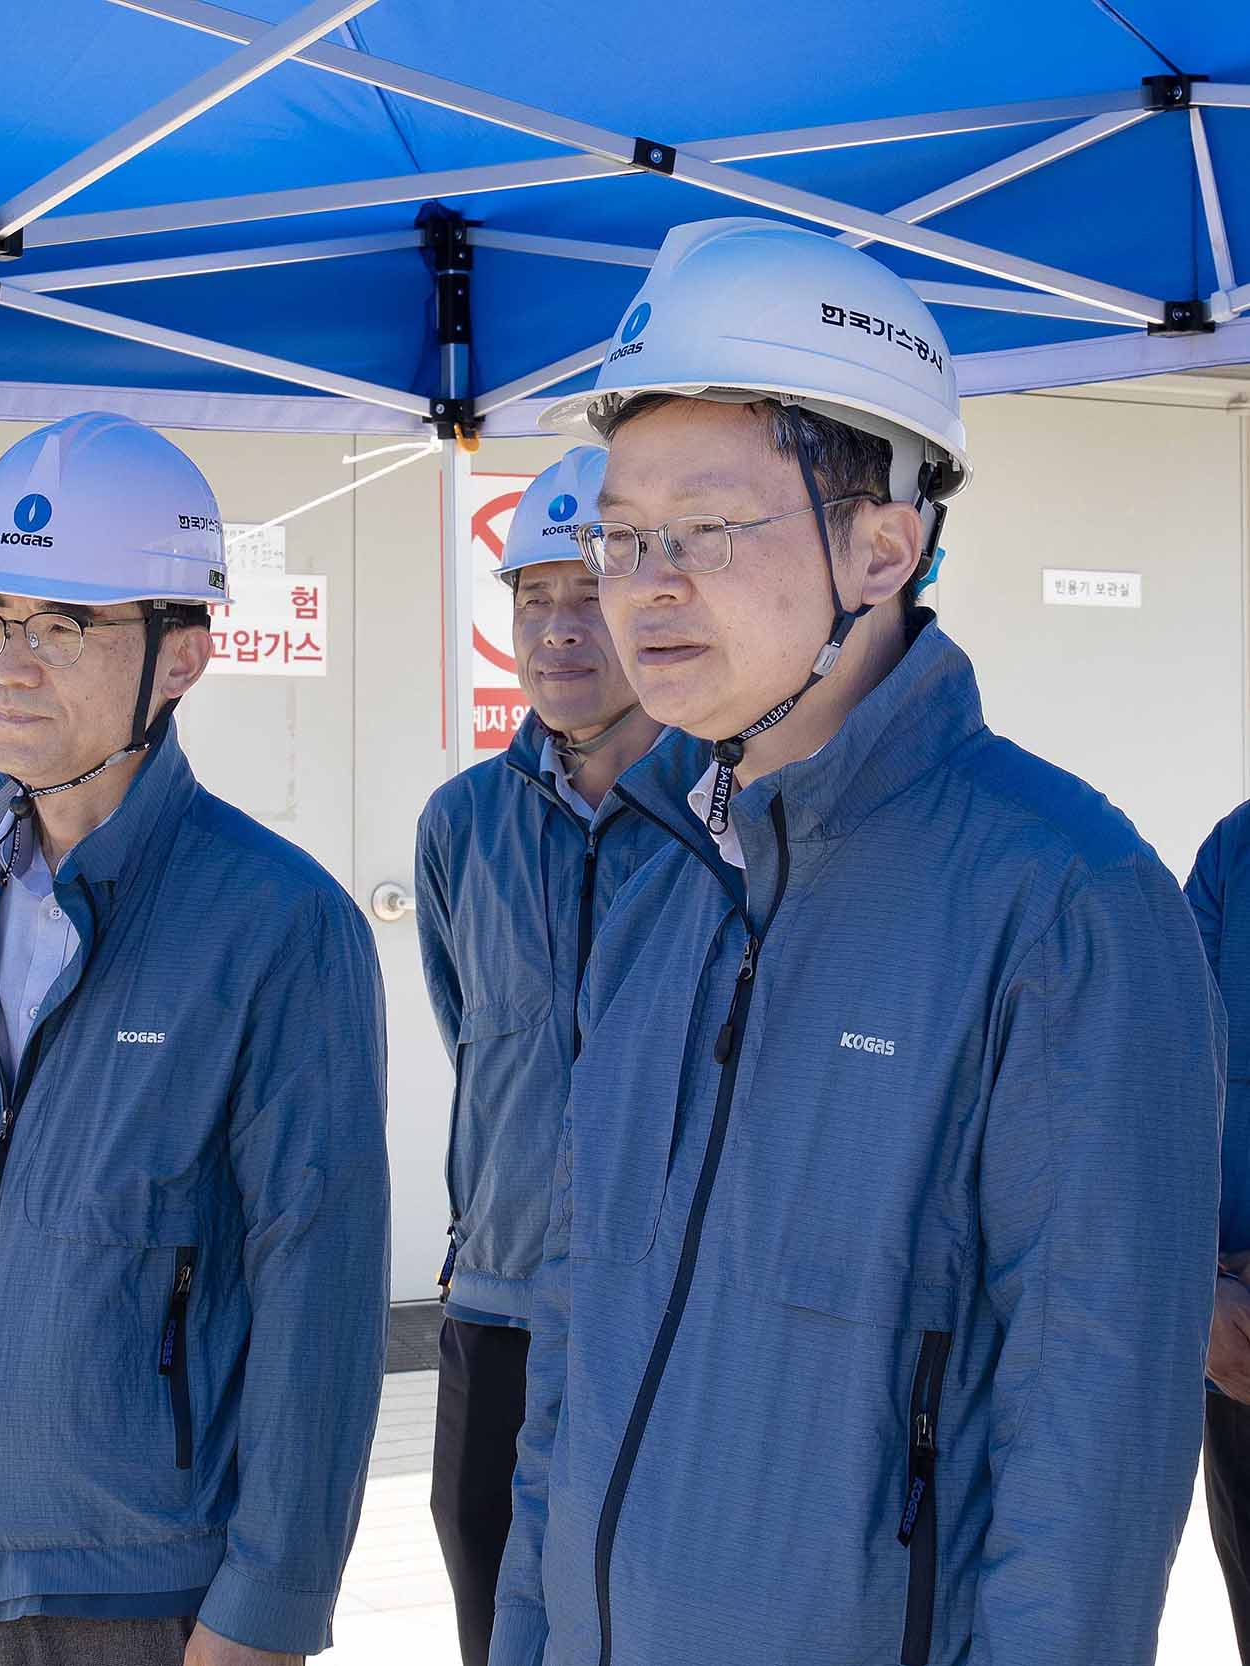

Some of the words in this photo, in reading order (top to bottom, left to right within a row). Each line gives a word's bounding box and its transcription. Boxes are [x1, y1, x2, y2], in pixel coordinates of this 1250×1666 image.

[820, 302, 943, 375] 한국가스공사
[471, 703, 508, 733] 계자
[761, 697, 794, 729] SAFETY
[714, 766, 732, 811] SAFETY
